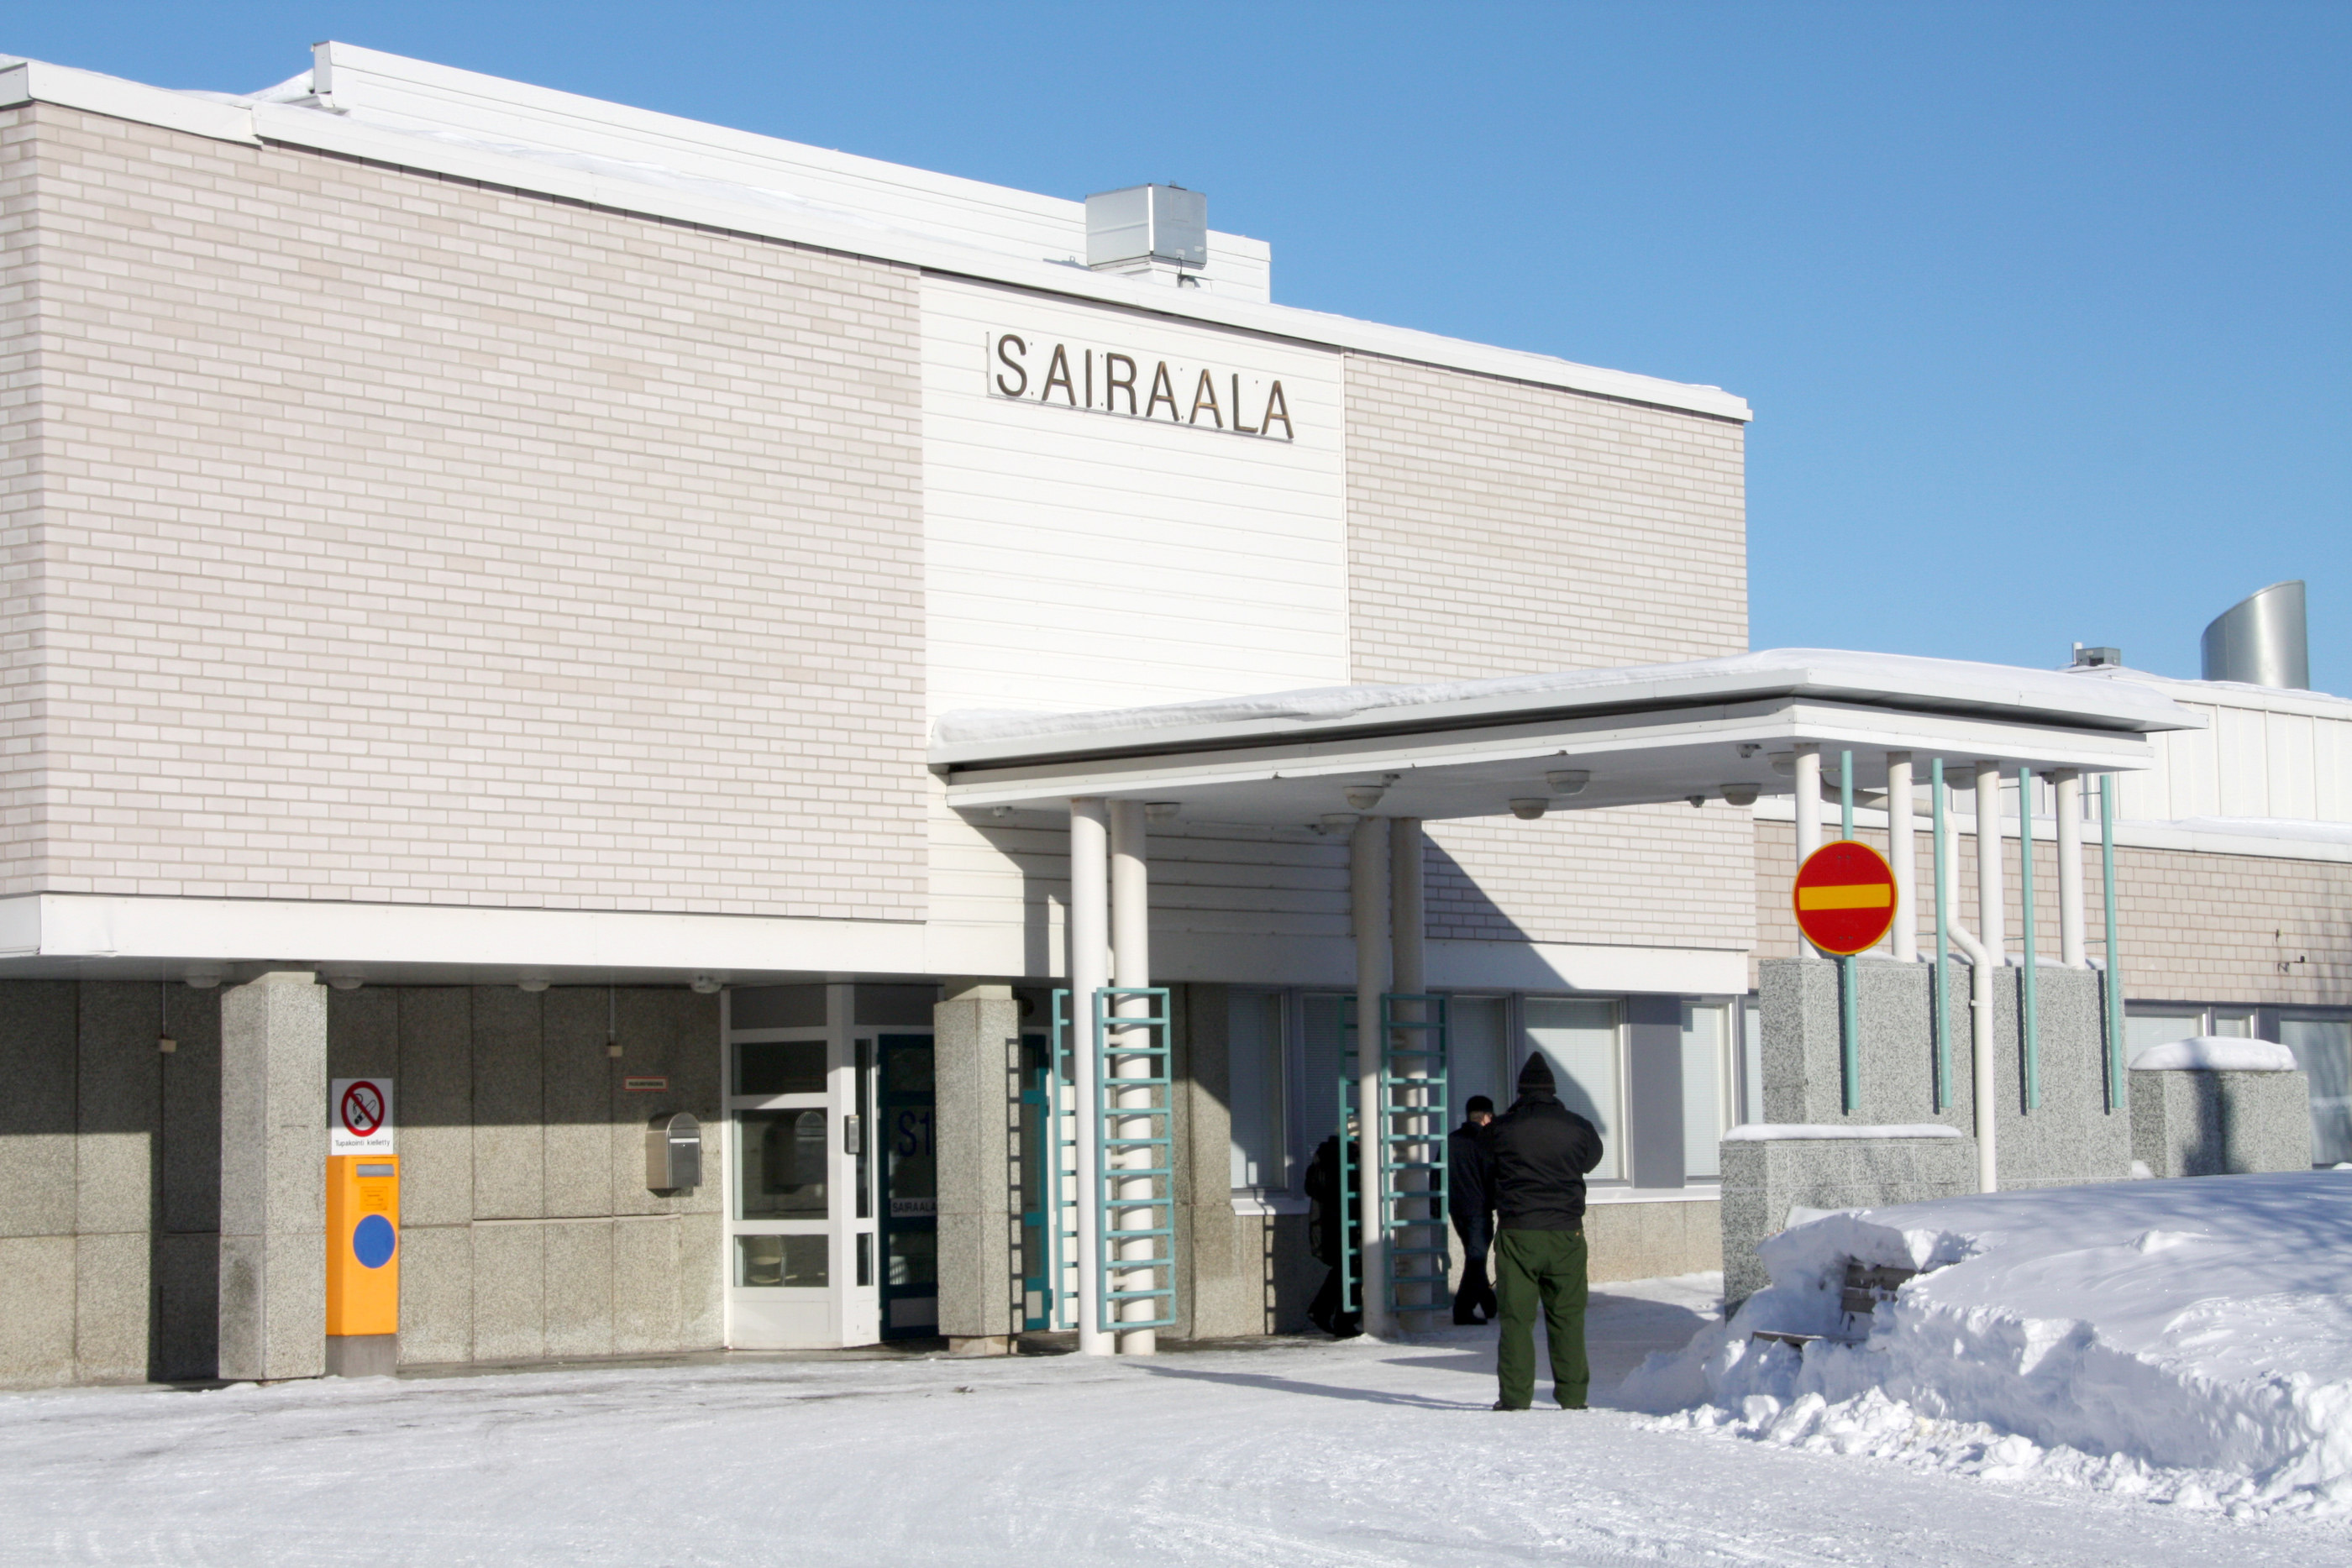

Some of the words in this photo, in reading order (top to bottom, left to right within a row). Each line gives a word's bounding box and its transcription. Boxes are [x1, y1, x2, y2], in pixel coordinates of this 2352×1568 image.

[997, 333, 1294, 439] SAIRAALA
[334, 1139, 365, 1147] Tupakointi
[366, 1139, 390, 1147] kielletty
